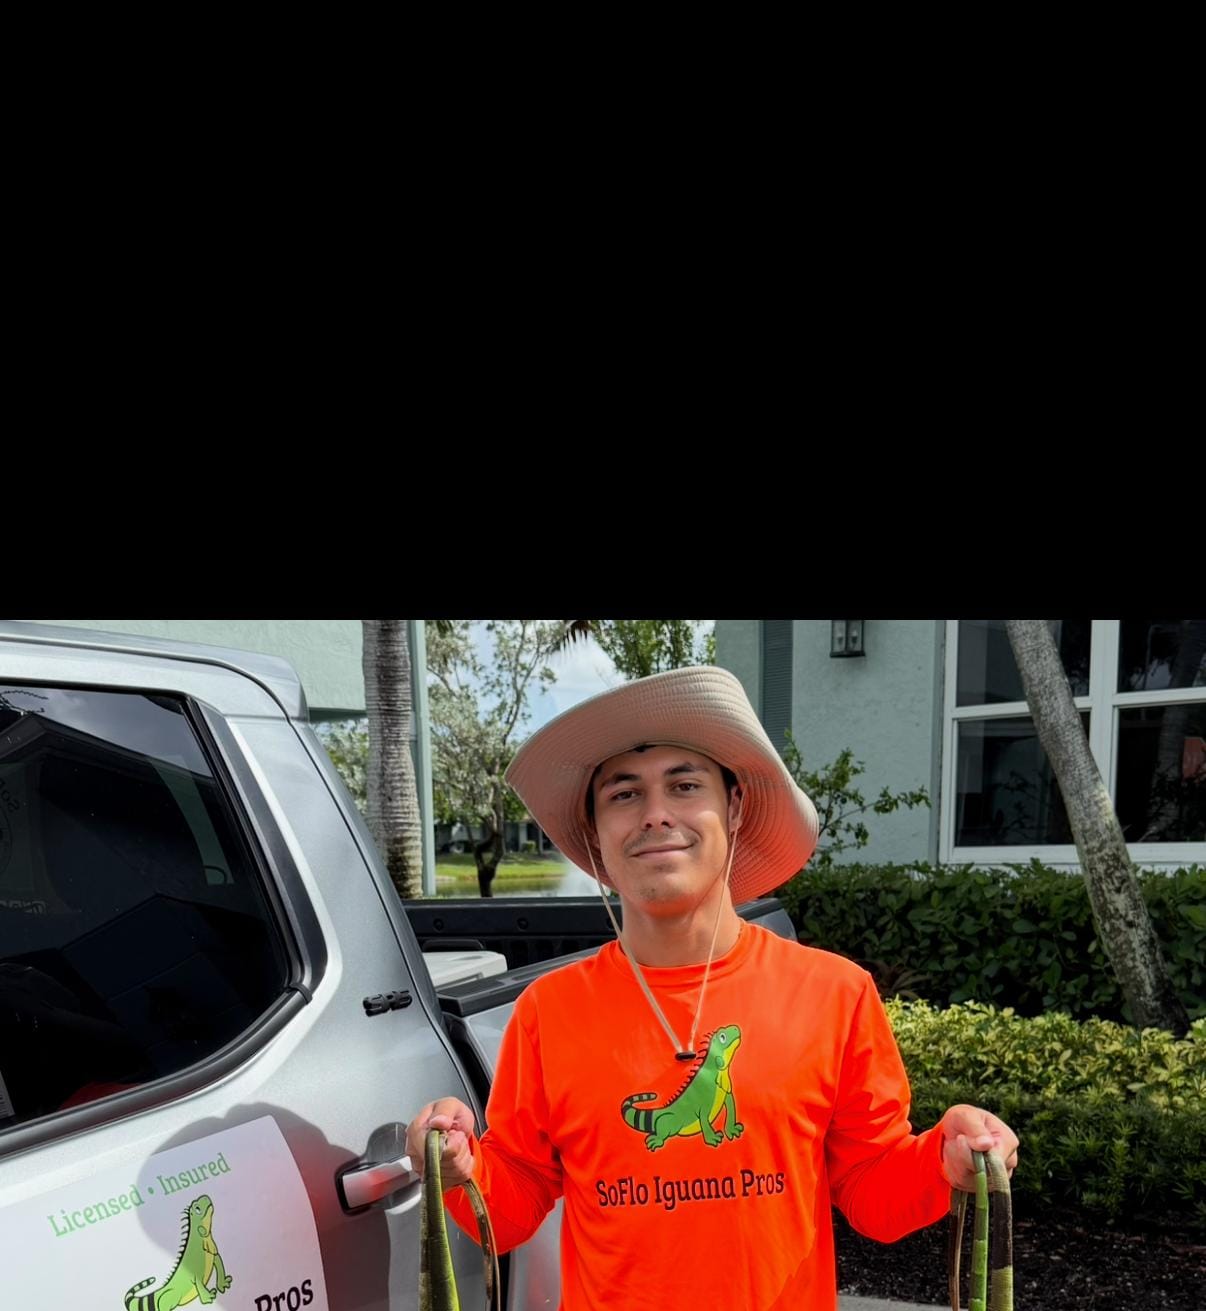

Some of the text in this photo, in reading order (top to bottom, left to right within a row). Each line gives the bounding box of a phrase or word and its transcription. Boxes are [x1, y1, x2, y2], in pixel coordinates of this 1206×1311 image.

[47, 1152, 231, 1237] Licensed Insured
[595, 1169, 785, 1211] SoFlo Iguana Pros
